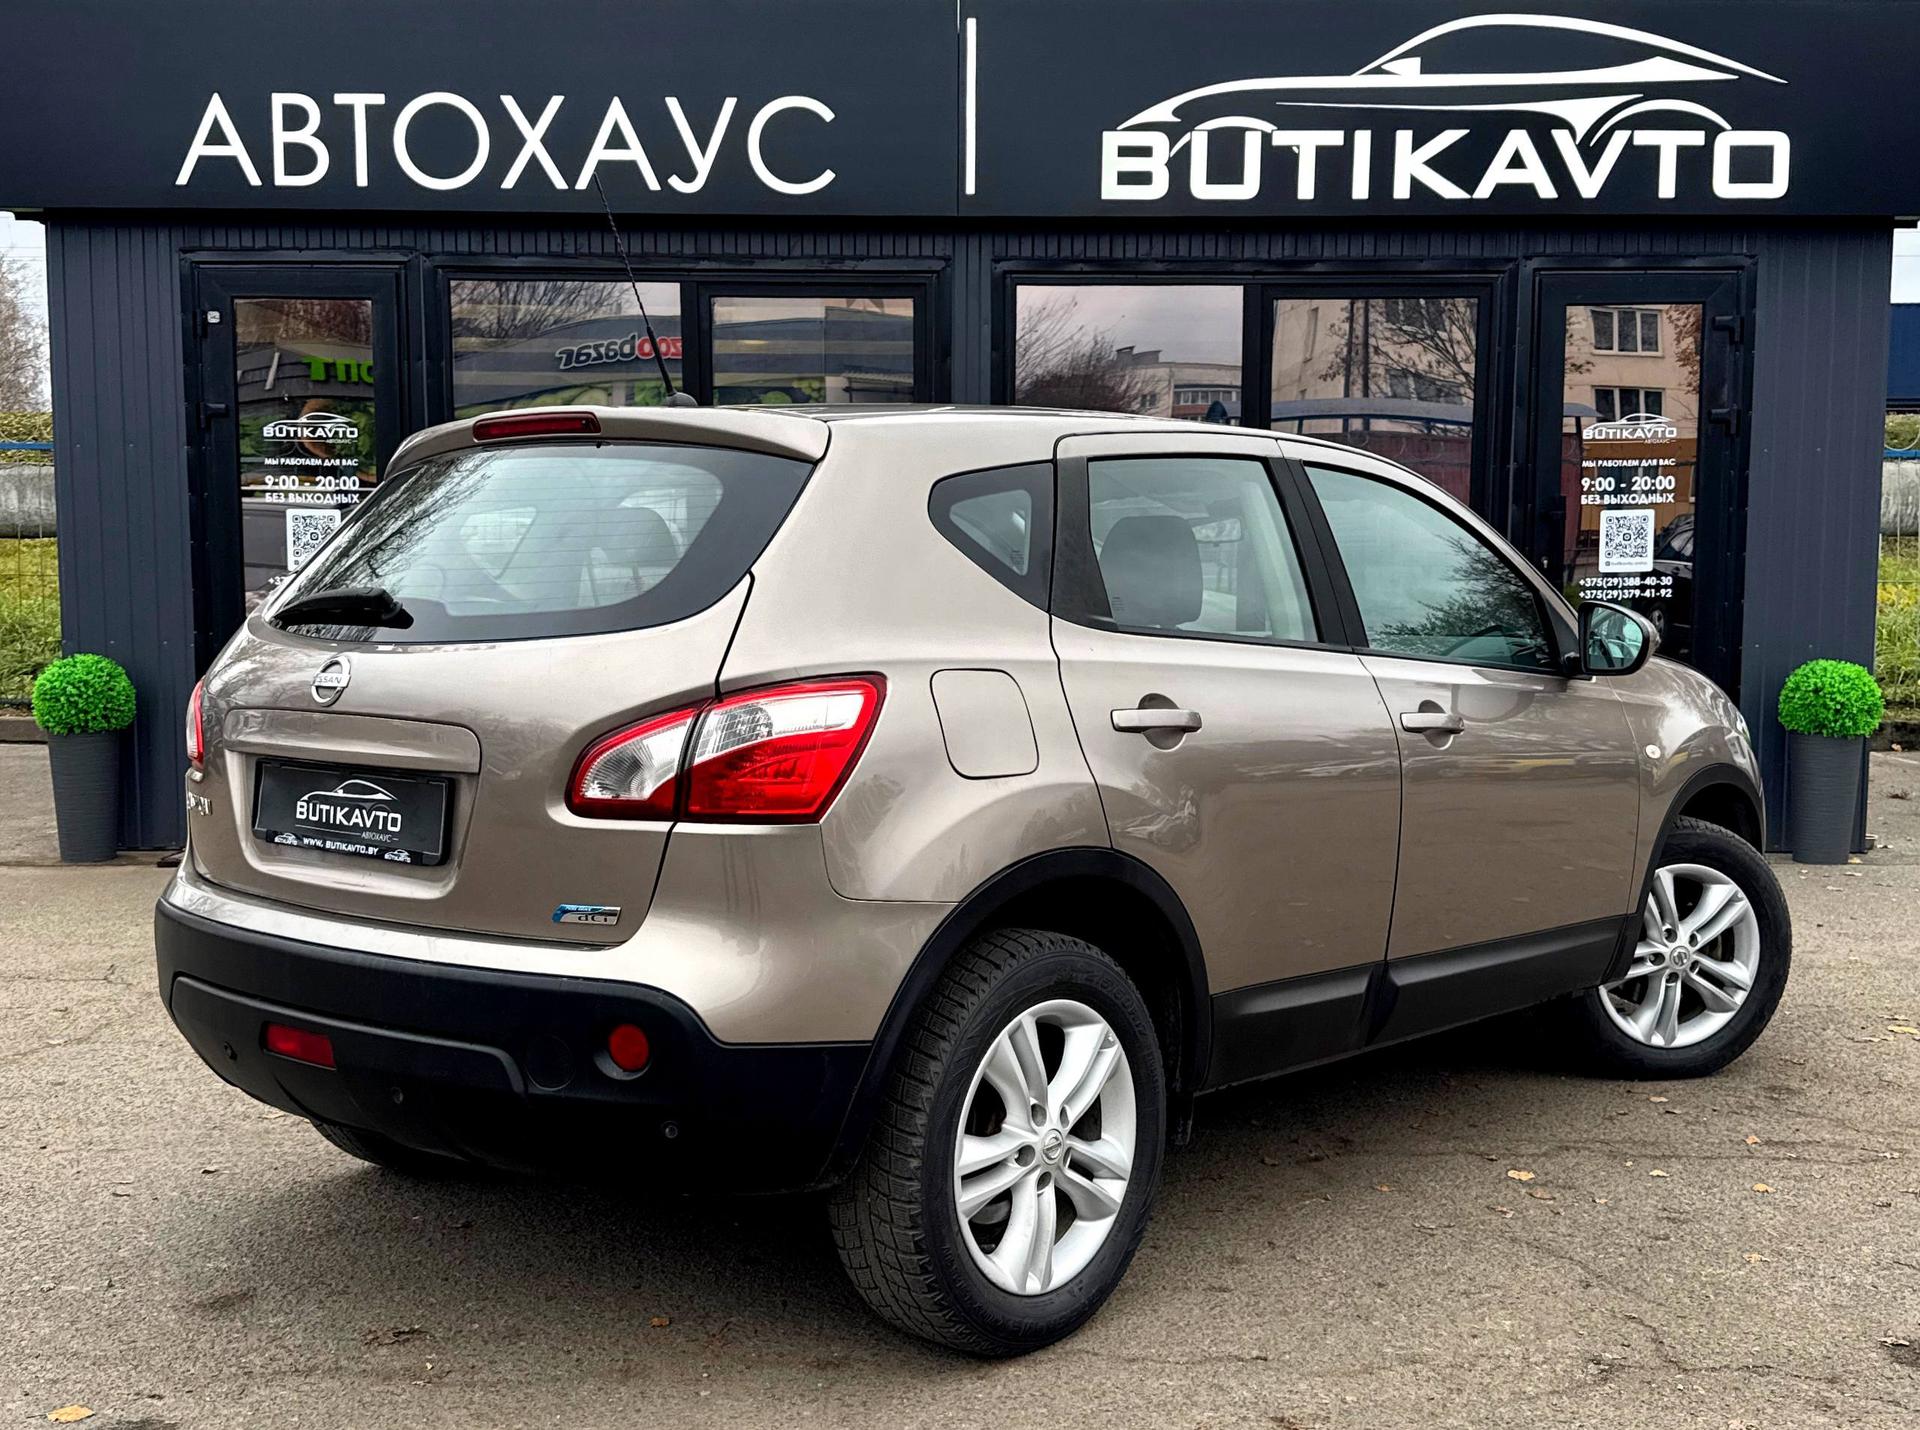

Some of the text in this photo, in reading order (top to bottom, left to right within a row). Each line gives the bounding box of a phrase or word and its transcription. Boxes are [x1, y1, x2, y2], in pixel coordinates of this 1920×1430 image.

[175, 92, 836, 194] АВТОХАУС
[1101, 129, 1791, 200] BUTIKAVTO
[262, 426, 359, 438] BUTIKAVTO
[1582, 427, 1677, 439] BUTIKAVTO
[264, 458, 279, 466] МЫ
[280, 458, 322, 466] РАБОТАЕМ
[323, 459, 340, 467] ДЛЯ
[1597, 459, 1639, 467] РАБОТАЕМ
[264, 475, 299, 490] 9:00
[315, 476, 360, 491] 20:00
[1581, 477, 1615, 491] 9:00
[1631, 475, 1675, 491] 20:00
[264, 493, 360, 504] БЕЗ ВЫХОДНЫХ
[1580, 493, 1675, 505] БЕЗ ВЫХОДНЫХ
[1579, 576, 1673, 588] +375(29)388-40-30
[1579, 588, 1672, 601] +375(29)379-41-92
[295, 801, 402, 832] BUTIKAVTO
[325, 840, 379, 856] BUTIKAVTO.BY
[577, 913, 608, 923] dCi
